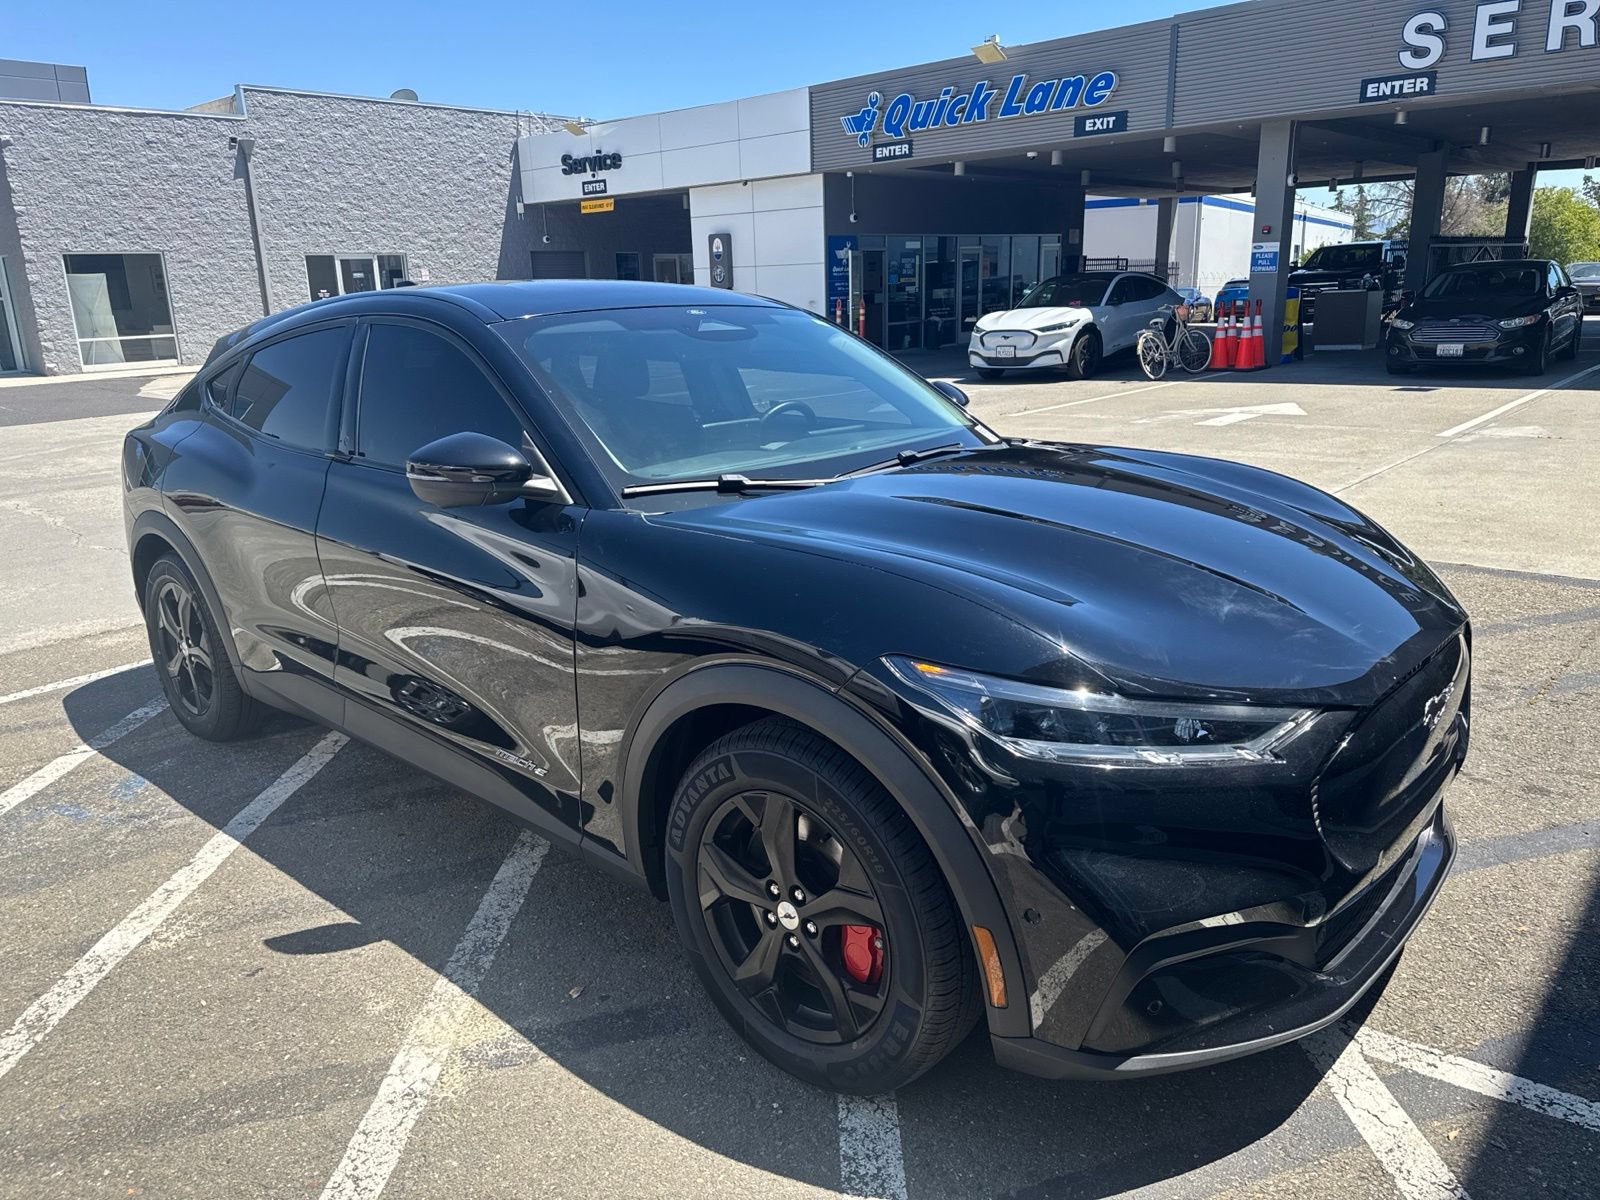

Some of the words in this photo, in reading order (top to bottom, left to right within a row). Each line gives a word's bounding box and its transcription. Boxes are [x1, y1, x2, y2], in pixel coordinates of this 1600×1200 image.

[1366, 77, 1429, 98] ENTER
[883, 80, 998, 139] Quick
[998, 71, 1119, 119] Lane
[1085, 116, 1117, 132] EXIT
[876, 143, 909, 159] ENTER
[561, 149, 622, 175] Service
[584, 182, 605, 192] ENTER
[671, 757, 732, 847] ADVANTA
